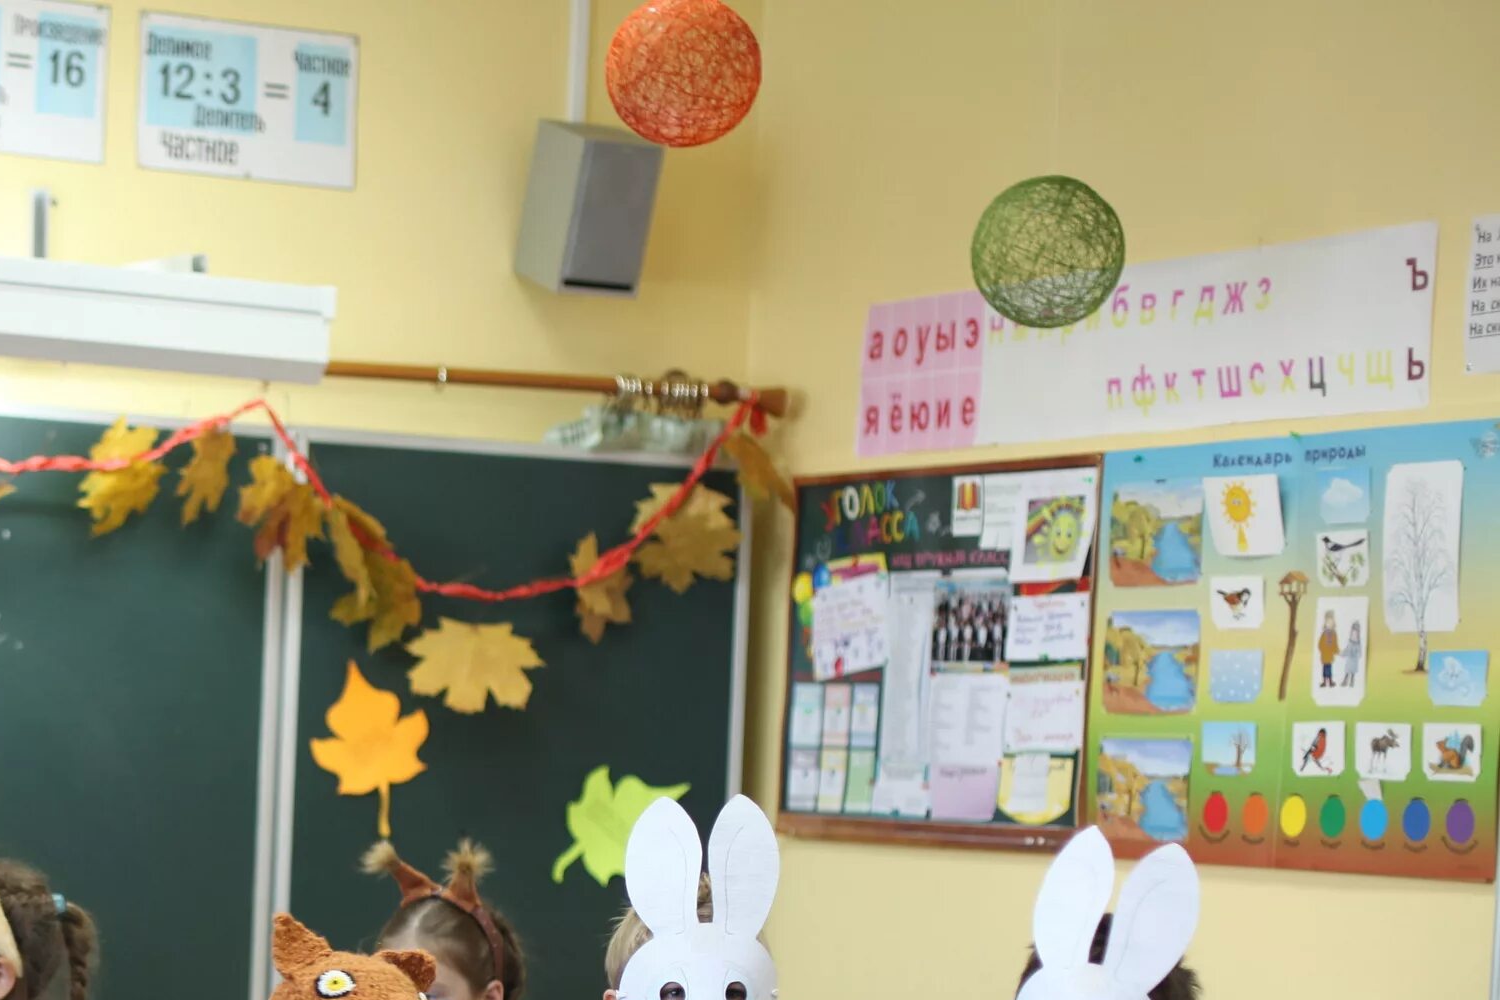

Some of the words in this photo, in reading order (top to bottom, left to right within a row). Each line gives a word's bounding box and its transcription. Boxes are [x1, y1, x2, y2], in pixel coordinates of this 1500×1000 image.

[146, 32, 213, 61] Делимое
[49, 48, 86, 88] 16
[293, 50, 351, 77] Частное
[311, 80, 332, 118] 4
[160, 131, 239, 166] Частное
[1475, 253, 1493, 267] Это
[1213, 452, 1292, 468] Календарь
[1304, 445, 1366, 464] природы
[820, 480, 900, 532] УГОЛОК
